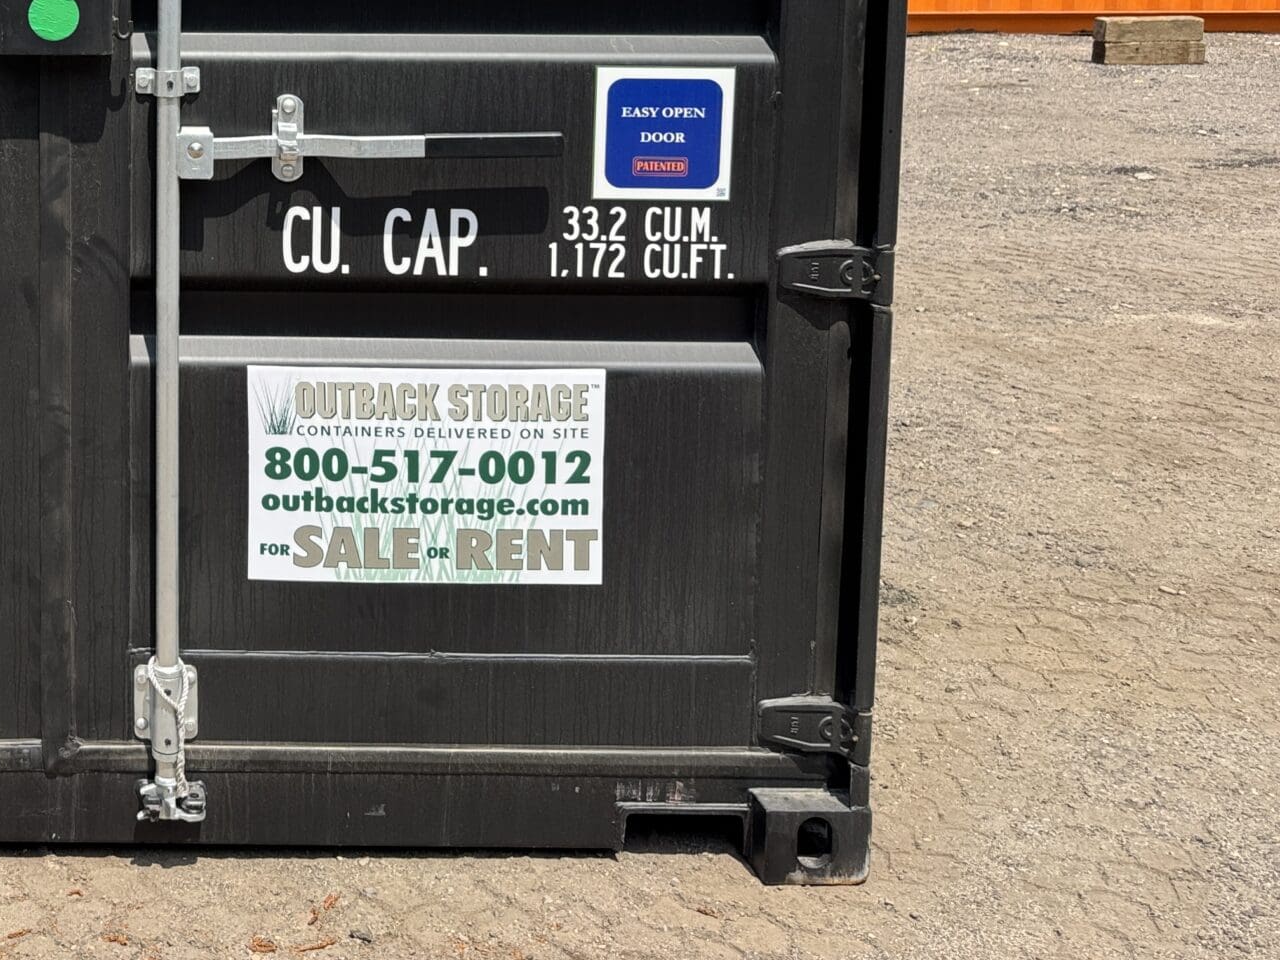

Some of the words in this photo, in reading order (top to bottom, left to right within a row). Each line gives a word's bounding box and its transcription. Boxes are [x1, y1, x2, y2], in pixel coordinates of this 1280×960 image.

[621, 107, 659, 118] EASY
[661, 107, 706, 118] OPEN
[640, 132, 686, 143] DOOR
[636, 160, 685, 172] PATENTED
[282, 205, 350, 275] CU.
[383, 207, 488, 277] CAP.
[562, 205, 627, 242] 33.2
[644, 206, 718, 243] CU.M.
[548, 242, 627, 279] 1,172
[643, 244, 735, 280] CU.FT.
[295, 381, 440, 421] OUTBACK
[447, 383, 589, 422] STORAGE
[296, 425, 406, 438] CONTAINERS
[414, 426, 511, 439] DELIVERED
[520, 427, 545, 439] ON
[552, 427, 590, 439] SITE
[264, 446, 592, 485] 800-517-0012
[261, 487, 590, 521] outbackstorage.com
[259, 542, 290, 556] FOR
[292, 524, 421, 570] SALE
[426, 546, 450, 560] OR
[455, 528, 599, 571] RENT
